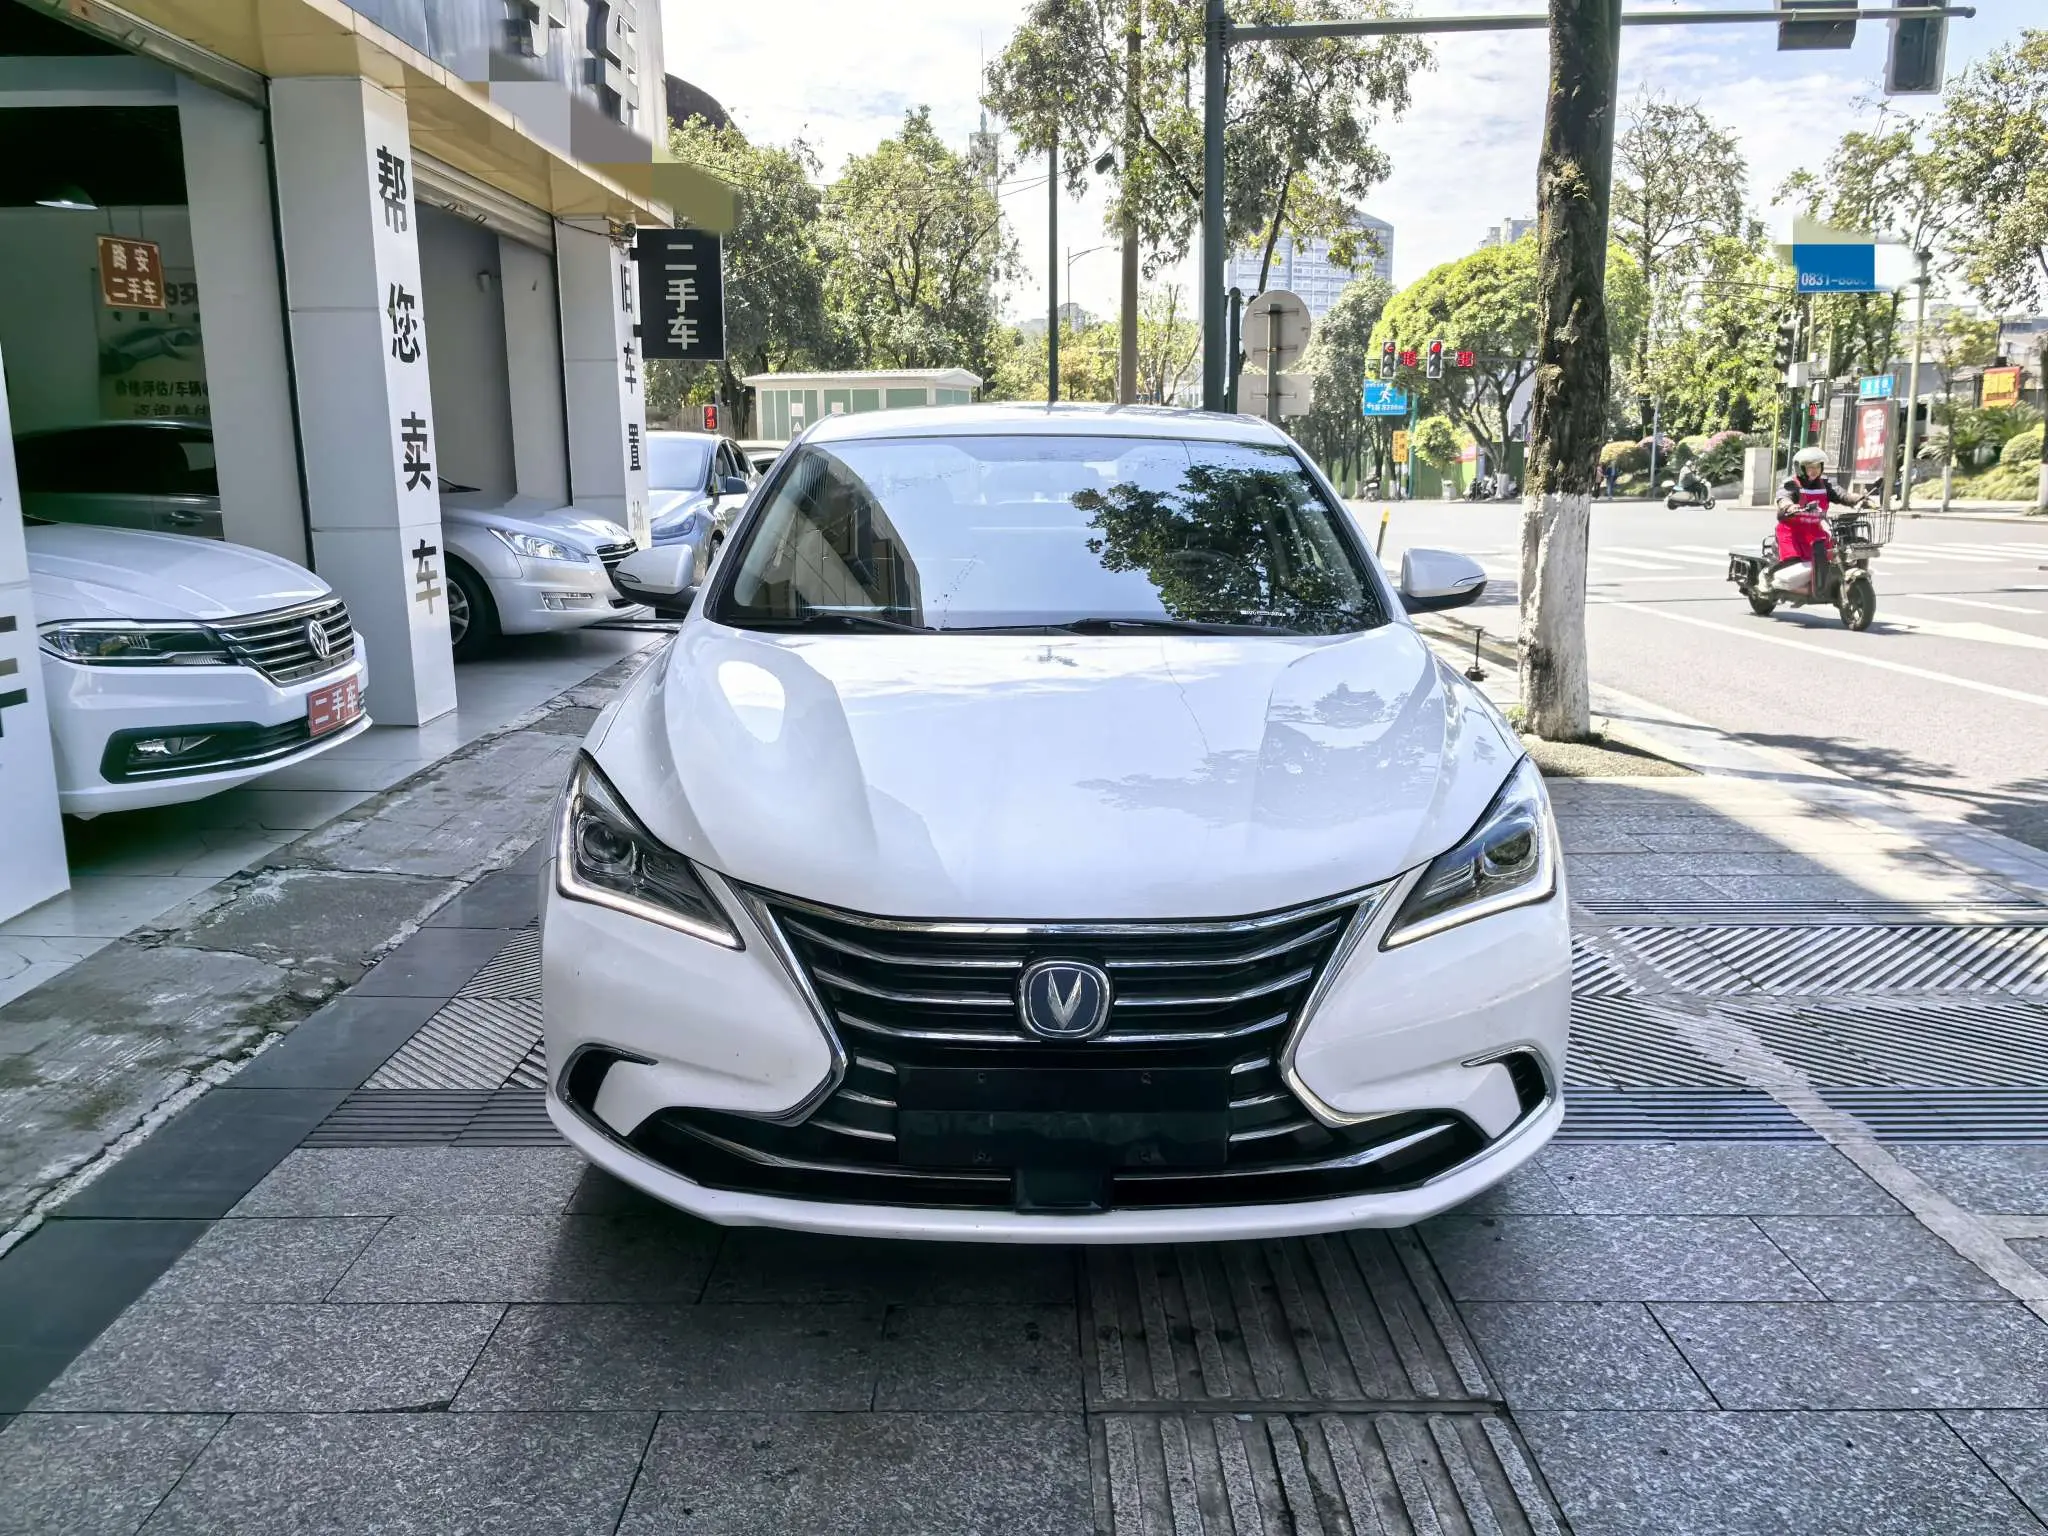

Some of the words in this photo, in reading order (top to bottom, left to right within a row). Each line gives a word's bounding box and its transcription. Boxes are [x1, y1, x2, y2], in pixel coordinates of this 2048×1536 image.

[111, 277, 159, 303] 二手车
[664, 243, 700, 351] 二手车
[1801, 272, 1869, 286] 0831-
[376, 145, 443, 614] 帮您卖车
[314, 683, 359, 724] 二手车
